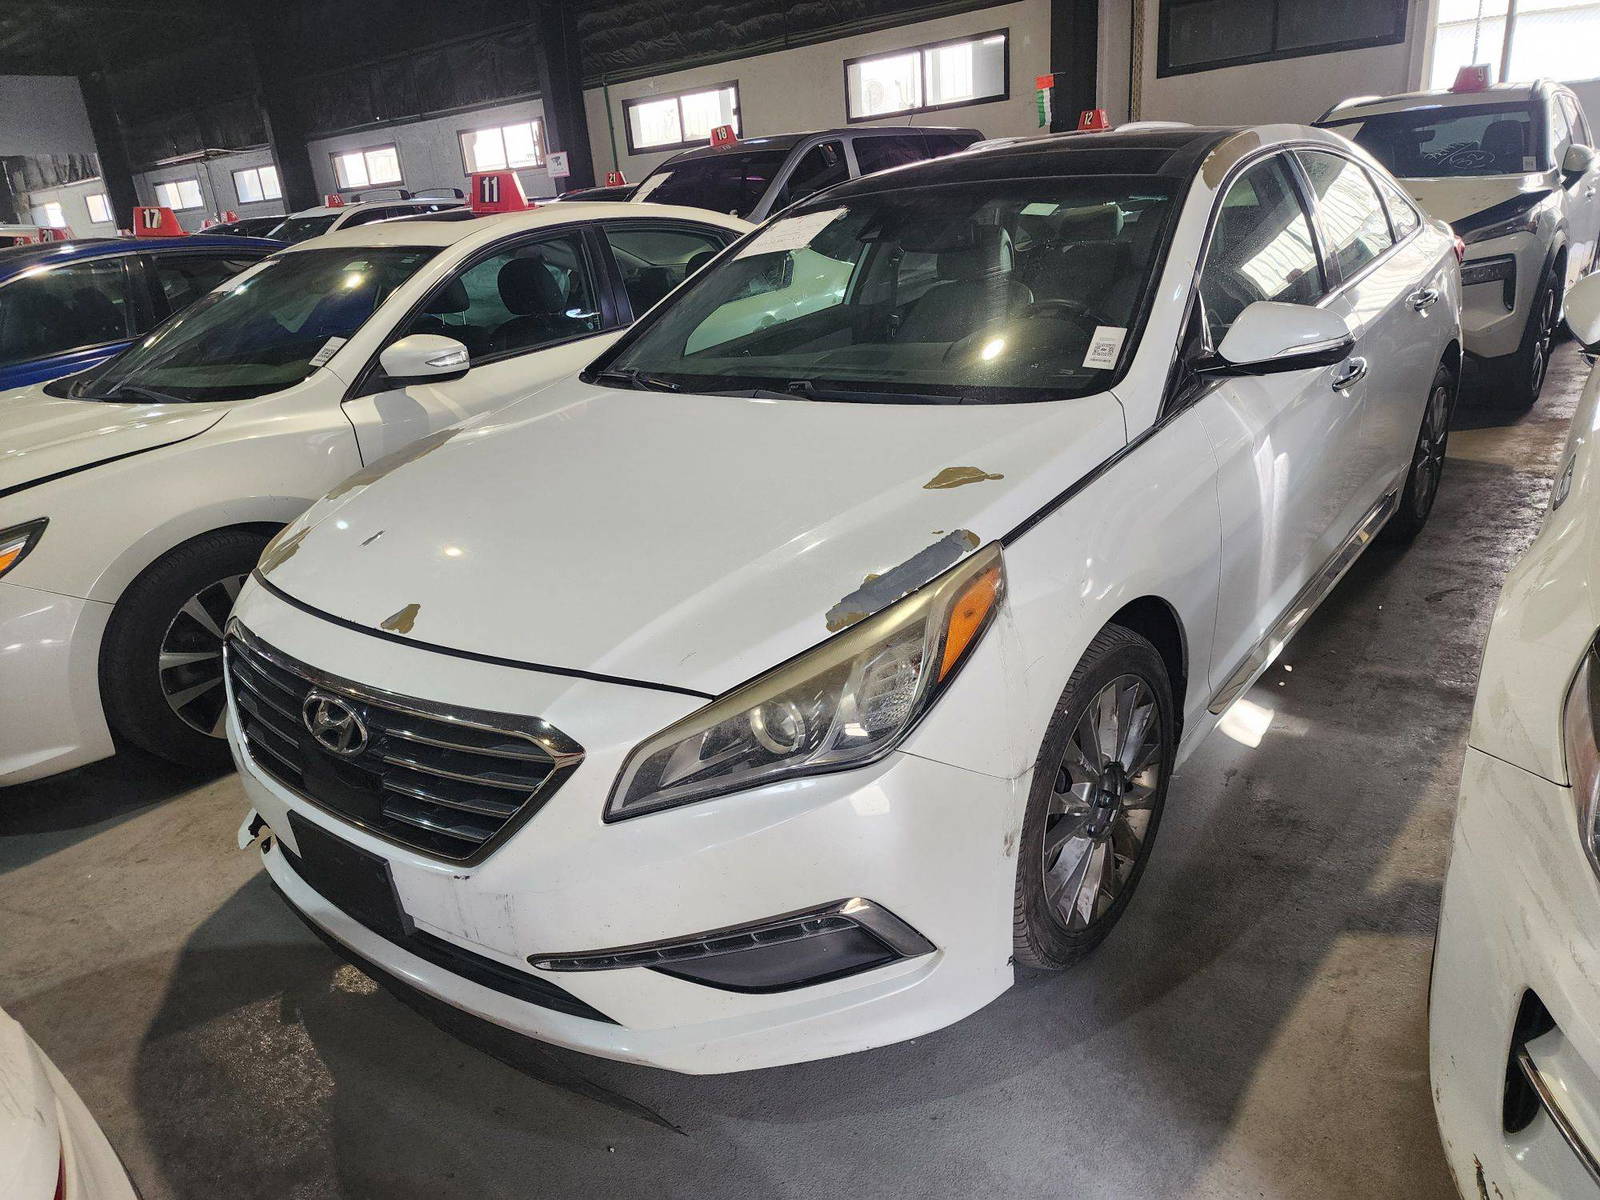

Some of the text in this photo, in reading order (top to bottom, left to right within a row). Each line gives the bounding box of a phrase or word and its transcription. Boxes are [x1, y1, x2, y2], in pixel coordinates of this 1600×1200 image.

[1084, 111, 1094, 125] 12
[716, 127, 728, 141] 18
[481, 176, 498, 203] 11
[143, 208, 160, 229] 17
